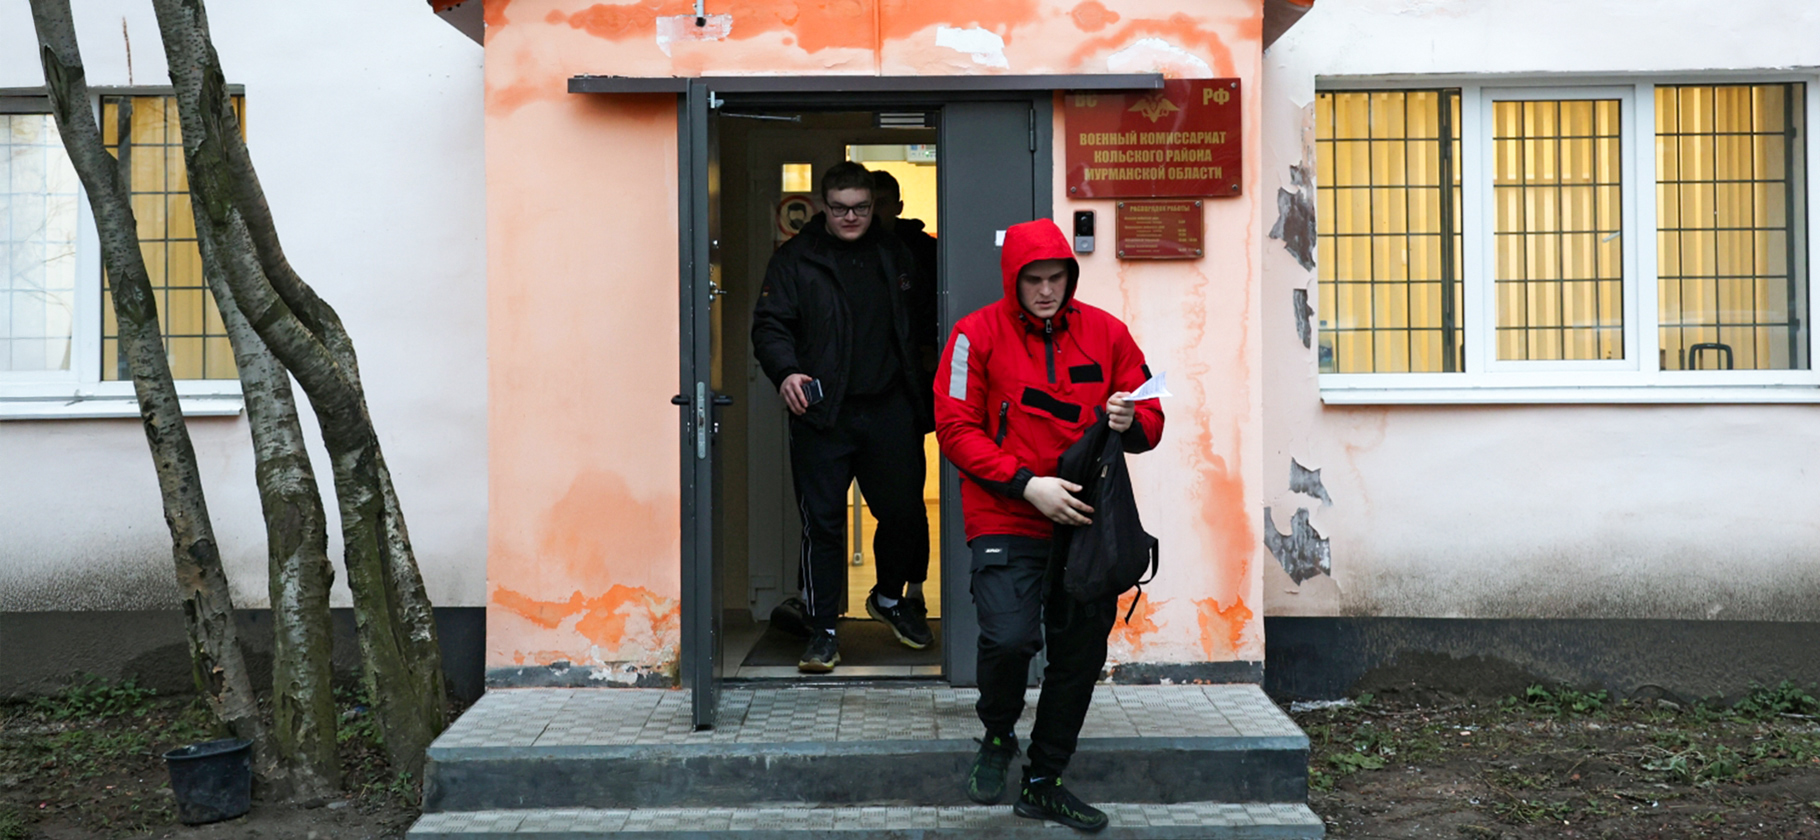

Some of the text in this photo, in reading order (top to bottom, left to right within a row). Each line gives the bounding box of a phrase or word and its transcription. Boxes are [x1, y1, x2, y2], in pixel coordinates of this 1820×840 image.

[1203, 88, 1230, 105] РФ
[1080, 131, 1226, 145] ВОЕННЫЙ КОМИССАРИАТ
[1094, 148, 1212, 163] КОЛЬСКОГО РАЙОНА
[1084, 165, 1222, 180] МУРМАНСКОЙ ОБЛАСТИ
